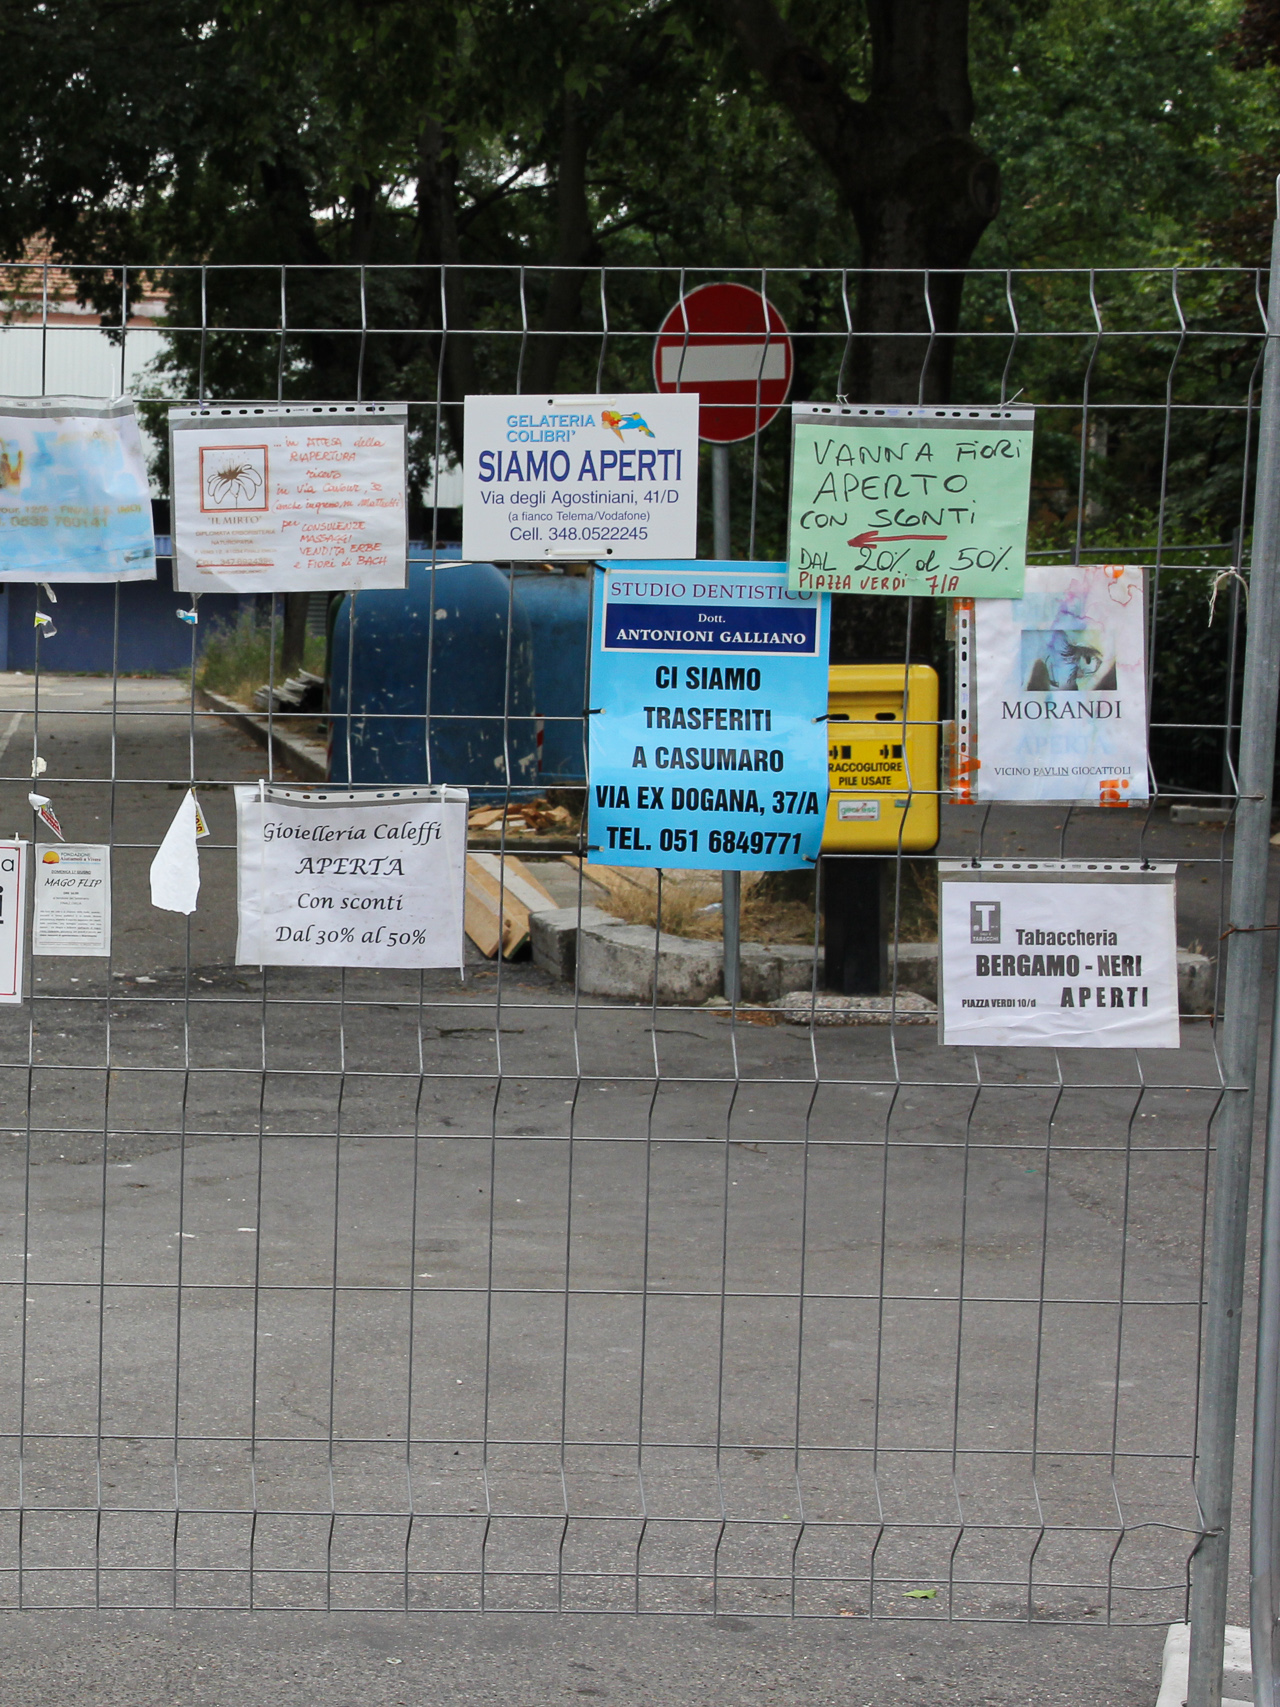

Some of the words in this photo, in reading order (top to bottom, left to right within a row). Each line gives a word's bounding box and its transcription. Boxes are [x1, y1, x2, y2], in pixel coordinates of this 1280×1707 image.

[506, 414, 596, 428] GELATERIA
[307, 437, 342, 447] ATTESA
[289, 451, 357, 462] RIAPERTURA
[813, 439, 933, 467] VANNA
[478, 450, 570, 482] SIAMO
[577, 449, 682, 482] APERTI
[813, 472, 968, 504] APERTO
[480, 490, 505, 504] Via
[510, 490, 546, 507] degli
[551, 490, 638, 507] Agostiniani,
[643, 489, 679, 504] 41/D
[508, 511, 519, 522] (a
[521, 511, 553, 521] fianco
[556, 510, 651, 522] Telema/Vodafone)
[800, 510, 848, 529] CON
[302, 521, 366, 532] CONSULENZE
[510, 527, 543, 541] Cell.
[548, 526, 648, 541] 348.0522245
[299, 546, 345, 556] VENDITA
[350, 542, 382, 553] ERBE
[357, 556, 387, 566] BACH
[797, 547, 837, 571] DAL
[854, 546, 911, 574] 20%
[949, 546, 1013, 573] 50%
[611, 582, 686, 597] STUDIO
[799, 571, 851, 591] PIAZZA
[925, 574, 959, 595] 7/A
[698, 613, 726, 623] Dott.
[616, 628, 714, 643] ANTONIONI
[719, 631, 806, 645] GALLIANO
[655, 665, 680, 689] CI
[685, 666, 761, 691] SIAMO
[643, 706, 772, 732] TRASFERITI
[1001, 700, 1122, 720] MORANDI
[632, 746, 648, 769] A
[655, 747, 784, 773] CASUMARO
[828, 762, 902, 772] RACCOGLITORE
[994, 767, 1031, 776] VICINO
[1071, 766, 1131, 775] GIOCATTOLI
[838, 776, 857, 786] PILE
[861, 776, 892, 785] USATE
[595, 785, 630, 809] VIA
[637, 786, 664, 810] EX
[671, 787, 765, 816] DOGANA,
[772, 791, 819, 815] 37/A
[263, 822, 367, 843] Gioielleria
[373, 821, 442, 846] Caleffi
[606, 826, 652, 851] TEL.
[659, 828, 698, 852] 051
[708, 830, 802, 855] 6849771
[295, 856, 405, 876] APERTA
[44, 878, 76, 887] MAGO
[77, 878, 102, 888] FLIP
[297, 893, 334, 909] Con
[340, 894, 404, 911] sconti
[276, 925, 315, 942] Dal
[316, 927, 355, 945] 30%
[361, 926, 386, 944] al
[387, 929, 427, 947] 50%
[1016, 929, 1118, 946] Tabaccheria
[976, 954, 1080, 977] BERGAMO
[1097, 955, 1142, 977] NERI
[961, 999, 990, 1008] PIAZZA
[991, 999, 1016, 1008] VERDI
[1017, 998, 1036, 1008] 10/d
[1060, 986, 1149, 1008] APERTI
